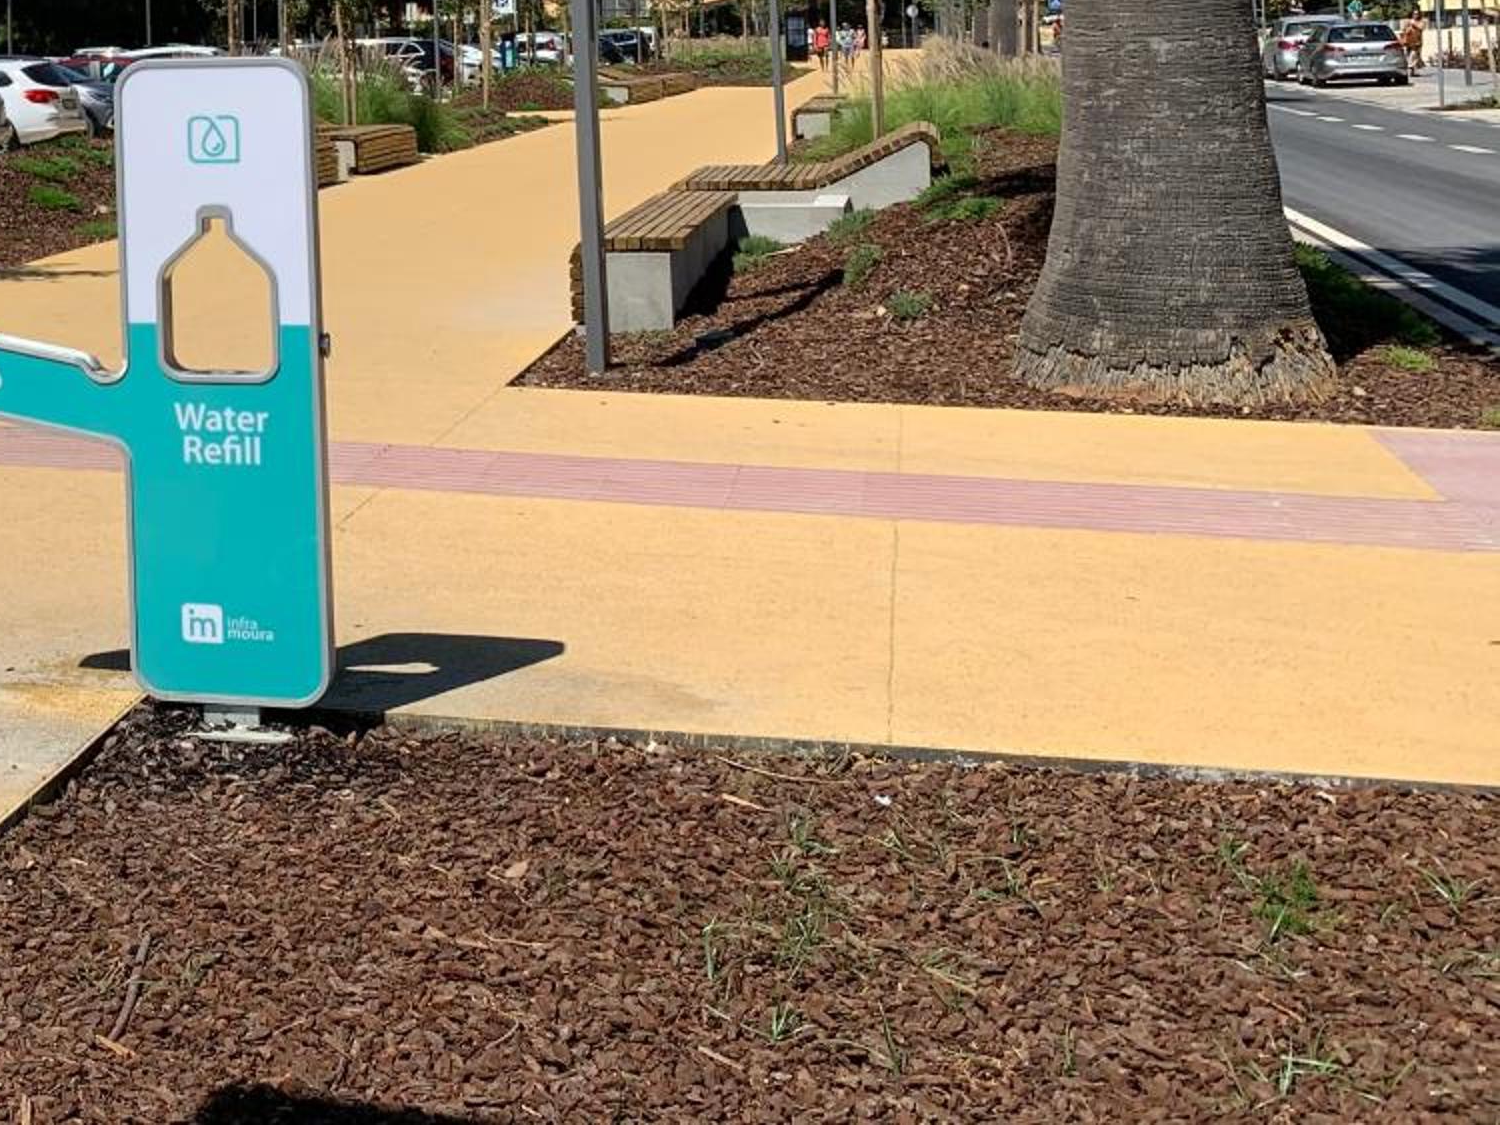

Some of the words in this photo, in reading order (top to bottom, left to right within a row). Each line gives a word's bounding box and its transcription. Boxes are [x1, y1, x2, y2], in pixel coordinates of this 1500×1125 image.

[174, 401, 269, 432] Water
[183, 434, 261, 465] Refill
[227, 630, 275, 642] moura
